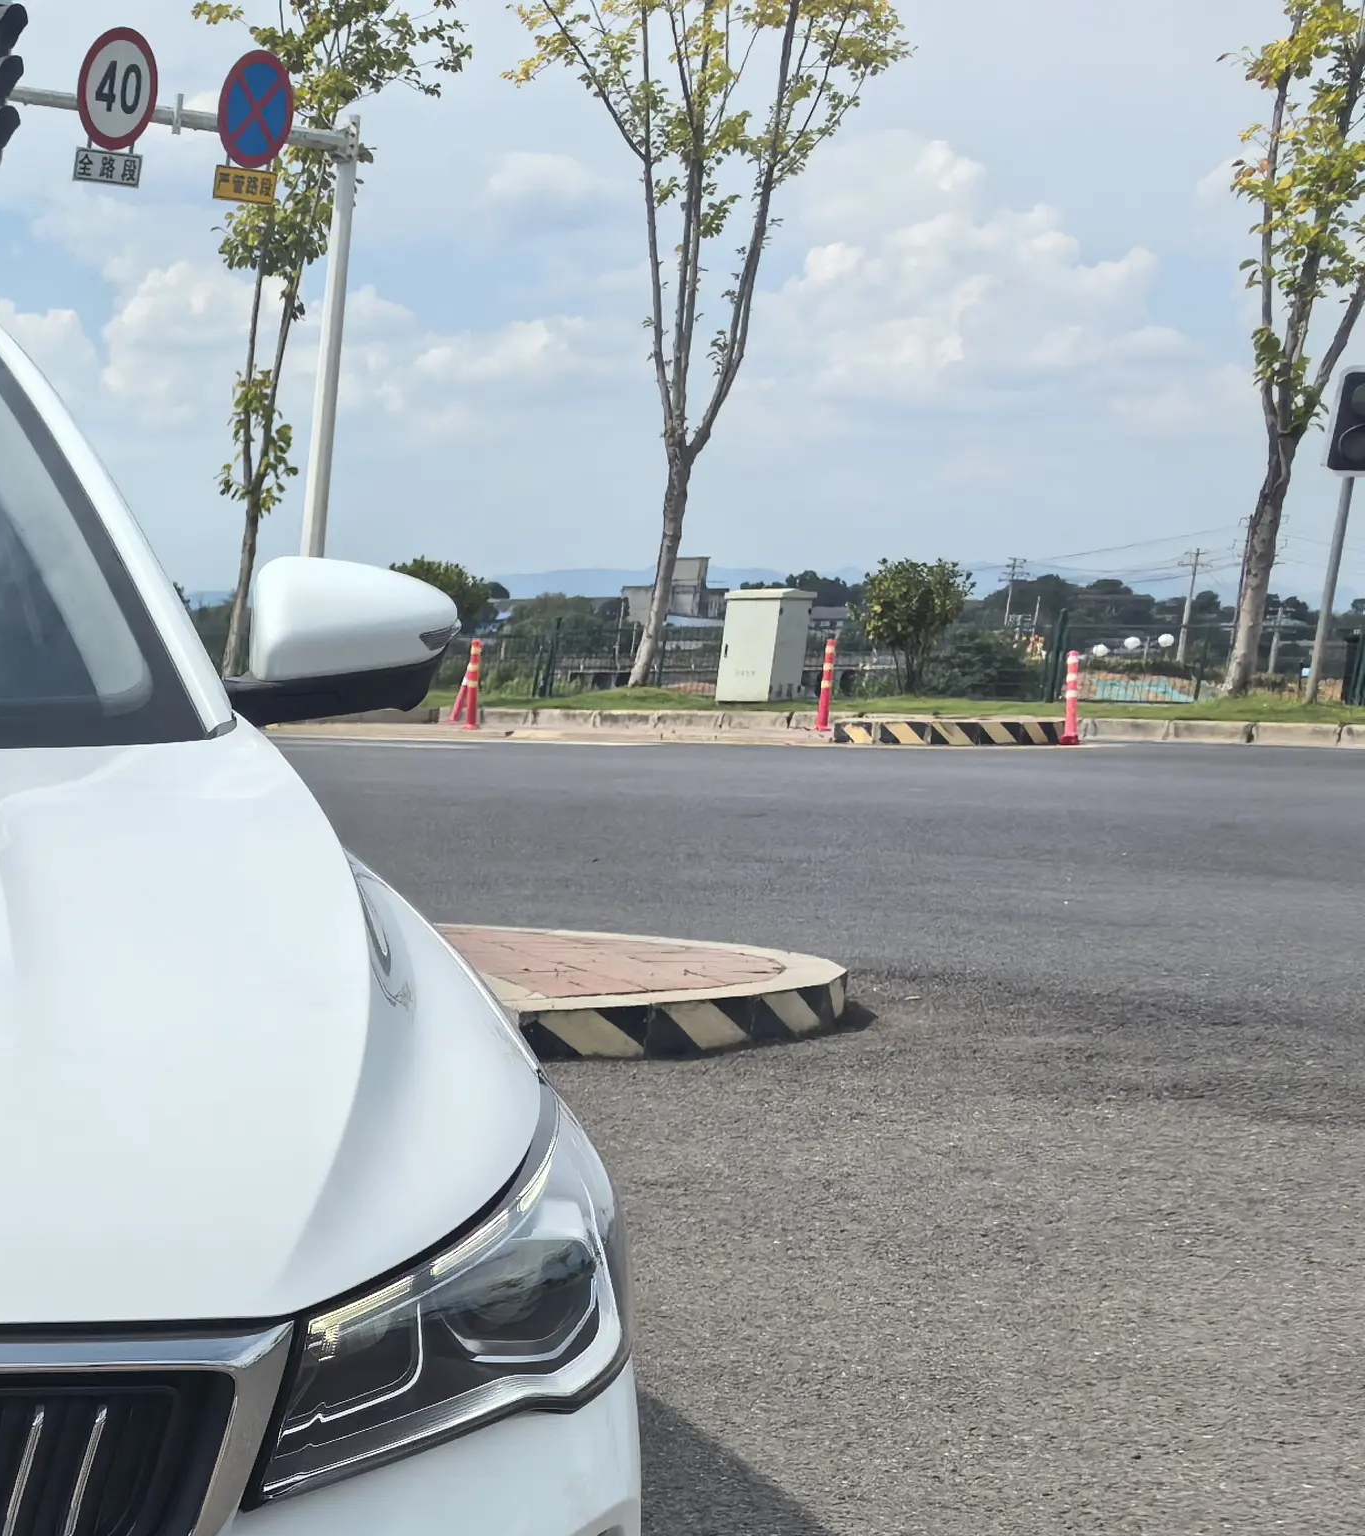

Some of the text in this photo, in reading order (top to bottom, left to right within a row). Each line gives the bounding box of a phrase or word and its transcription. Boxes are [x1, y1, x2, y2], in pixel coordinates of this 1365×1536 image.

[95, 60, 142, 115] 40
[77, 153, 138, 182] 全路段
